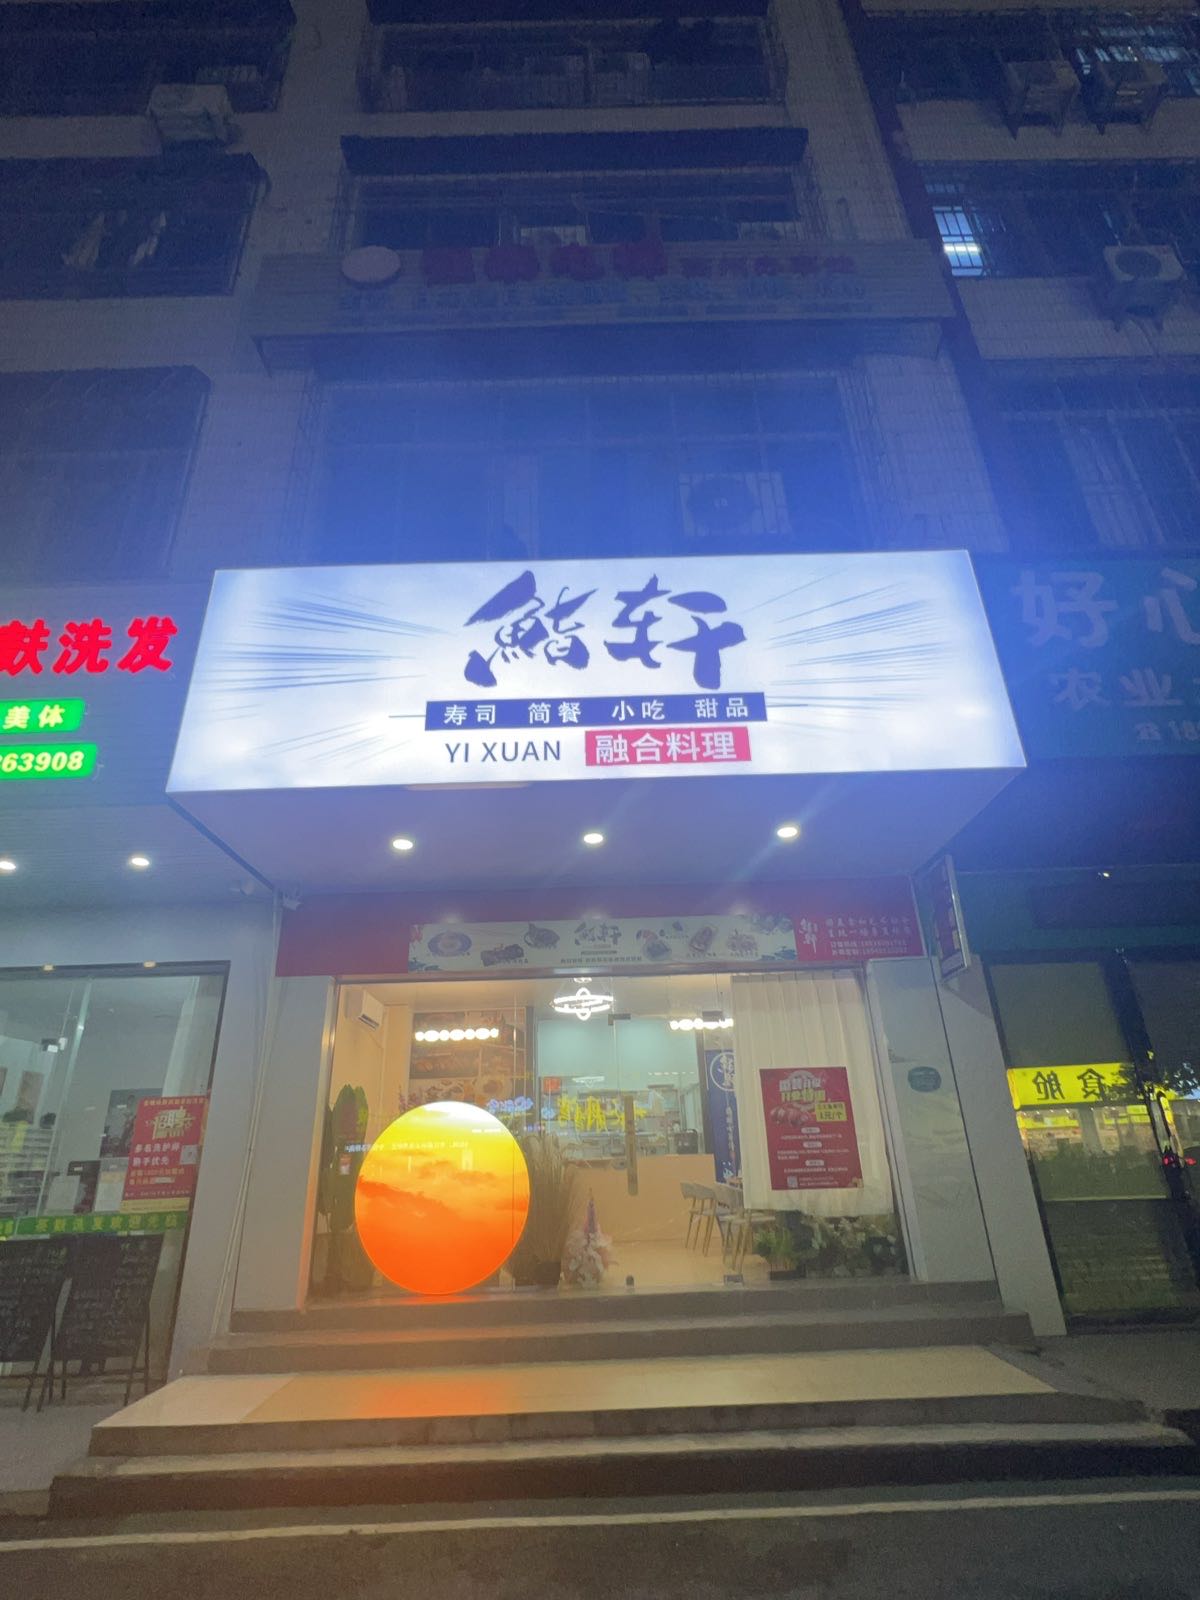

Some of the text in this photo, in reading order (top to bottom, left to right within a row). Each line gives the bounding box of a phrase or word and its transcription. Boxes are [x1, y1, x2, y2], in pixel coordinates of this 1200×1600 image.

[3, 704, 65, 729] 美体
[444, 697, 749, 726] 寿司 简餐 小吃 甜品
[445, 740, 561, 764] YI XUAN
[595, 732, 736, 763] 融合料理
[0, 751, 84, 773] 63908
